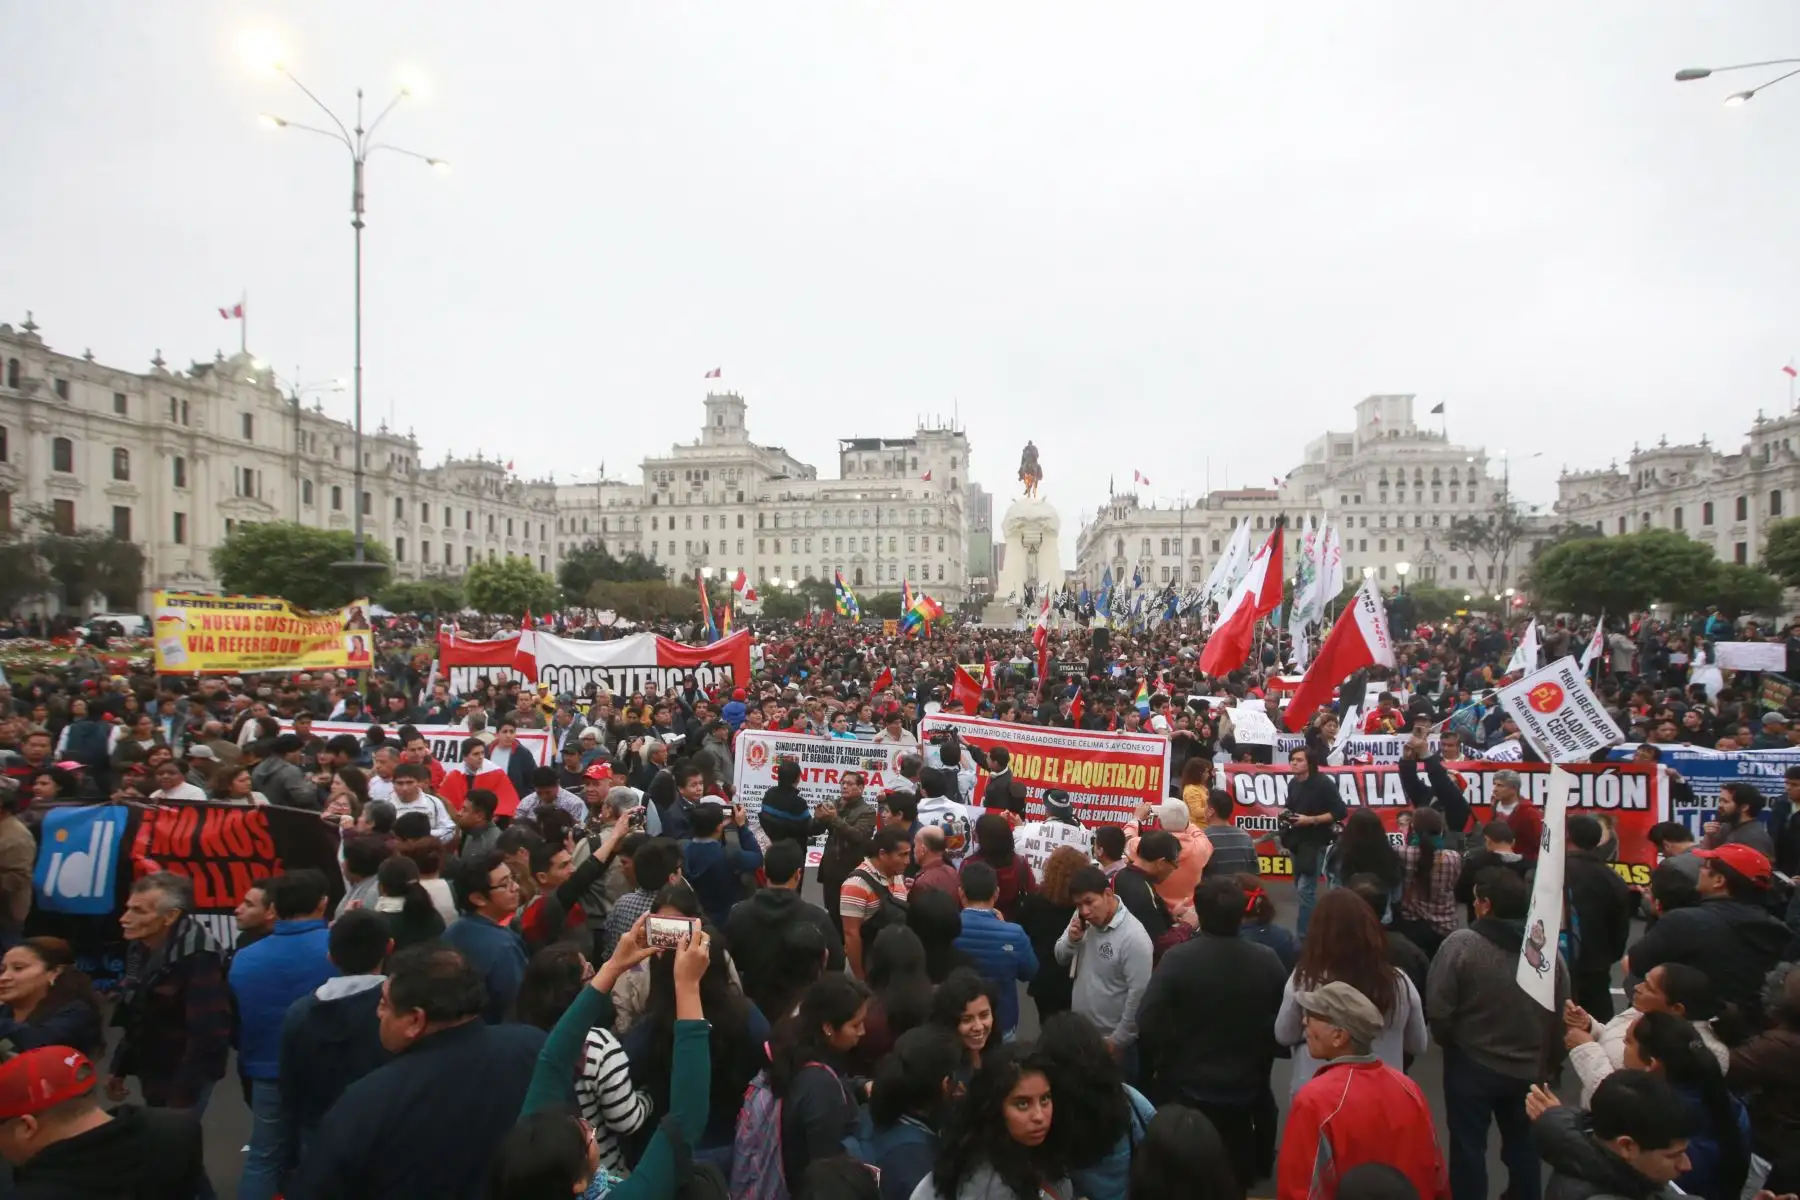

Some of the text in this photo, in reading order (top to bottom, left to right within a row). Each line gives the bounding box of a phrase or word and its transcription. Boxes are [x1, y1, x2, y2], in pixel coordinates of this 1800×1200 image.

[1532, 687, 1552, 710] PL
[1559, 668, 1578, 690] PERÚ
[1572, 689, 1617, 740] LIBERTARIO
[1512, 695, 1549, 742] PRESIDENTE
[1559, 707, 1599, 750] VLADIMIR
[775, 742, 888, 758] SINDICATO NACIONAL DE TRABAJADORES
[968, 726, 1001, 737] UNITARIO
[1003, 730, 1011, 738] DE
[1013, 732, 1066, 746] TRABAJADORES
[1067, 738, 1077, 746] DE
[1078, 739, 1104, 748] CELIMA
[1121, 743, 1155, 752] CONEXOS
[1346, 741, 1384, 756] CIONAL
[1386, 741, 1399, 756] DE
[801, 753, 860, 766] DE BEBIDAS Y AFINES
[771, 765, 884, 787] SNTRBA
[1008, 752, 1042, 780] BAJO
[1043, 756, 1060, 784] EL
[1062, 758, 1146, 791] PAQUETAZO
[1234, 773, 1360, 806] CONA
[1365, 772, 1407, 806] LA
[1101, 794, 1111, 805] EN
[1111, 795, 1119, 806] LA
[1119, 796, 1144, 808] LUCHA
[1077, 809, 1092, 820] LOS
[200, 806, 275, 859] NOS
[1039, 825, 1054, 839] MI
[1025, 838, 1040, 850] NO
